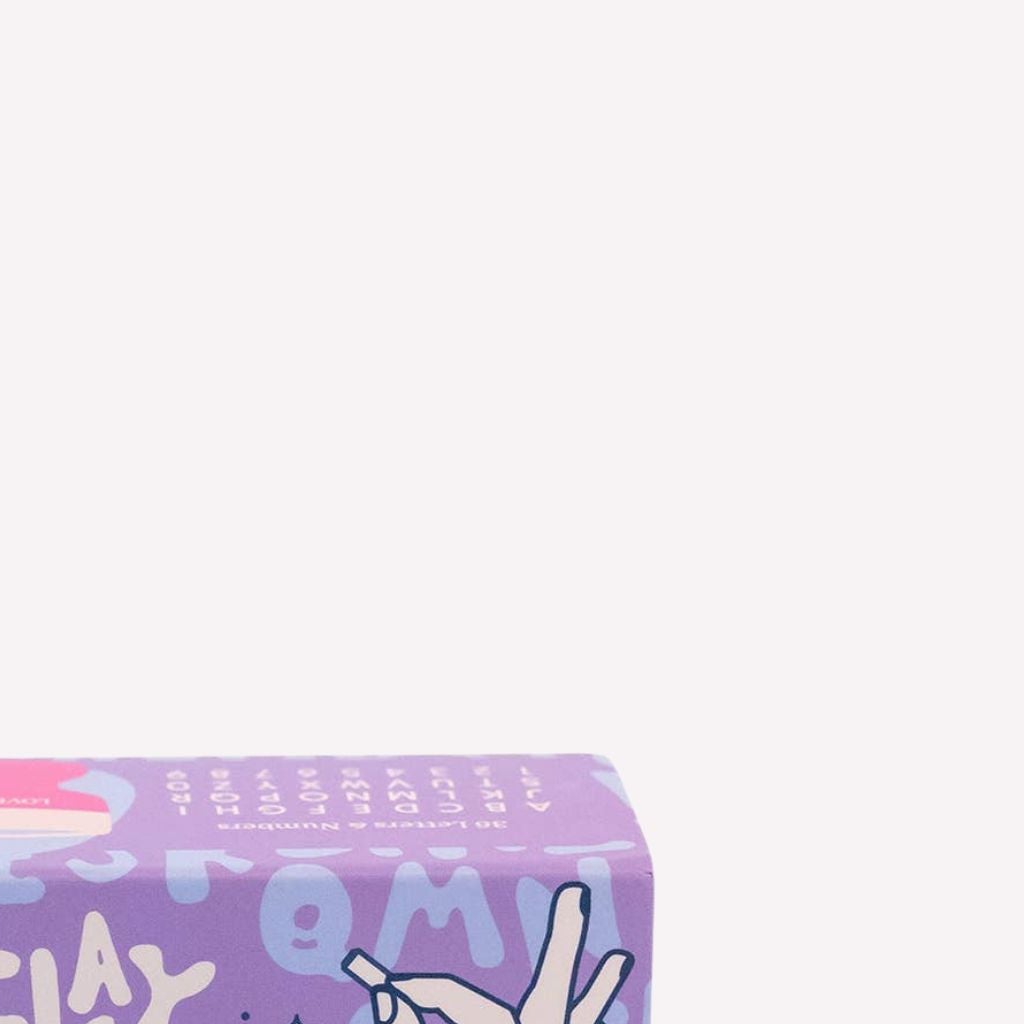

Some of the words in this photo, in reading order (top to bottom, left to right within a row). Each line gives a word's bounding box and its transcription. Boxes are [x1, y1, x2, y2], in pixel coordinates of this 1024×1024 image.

[214, 781, 231, 791] Z
[258, 781, 276, 790] Y
[298, 780, 320, 790] X
[341, 780, 370, 789] W
[388, 779, 413, 789] V
[432, 778, 455, 789] U
[171, 793, 191, 803] R
[260, 793, 280, 802] P
[298, 791, 328, 802] O
[345, 791, 370, 801] N
[388, 791, 417, 801] M
[438, 790, 455, 800] L
[480, 790, 503, 799] K
[527, 789, 542, 799] J
[215, 805, 240, 815] H
[258, 804, 286, 815] G
[308, 804, 325, 815] F
[353, 804, 371, 814] E
[394, 802, 418, 814] D
[438, 802, 464, 813] C
[485, 802, 506, 813] B
[526, 802, 551, 812] A
[217, 821, 340, 831] Numbers
[374, 820, 469, 830] Letters
[475, 820, 508, 830] 36
